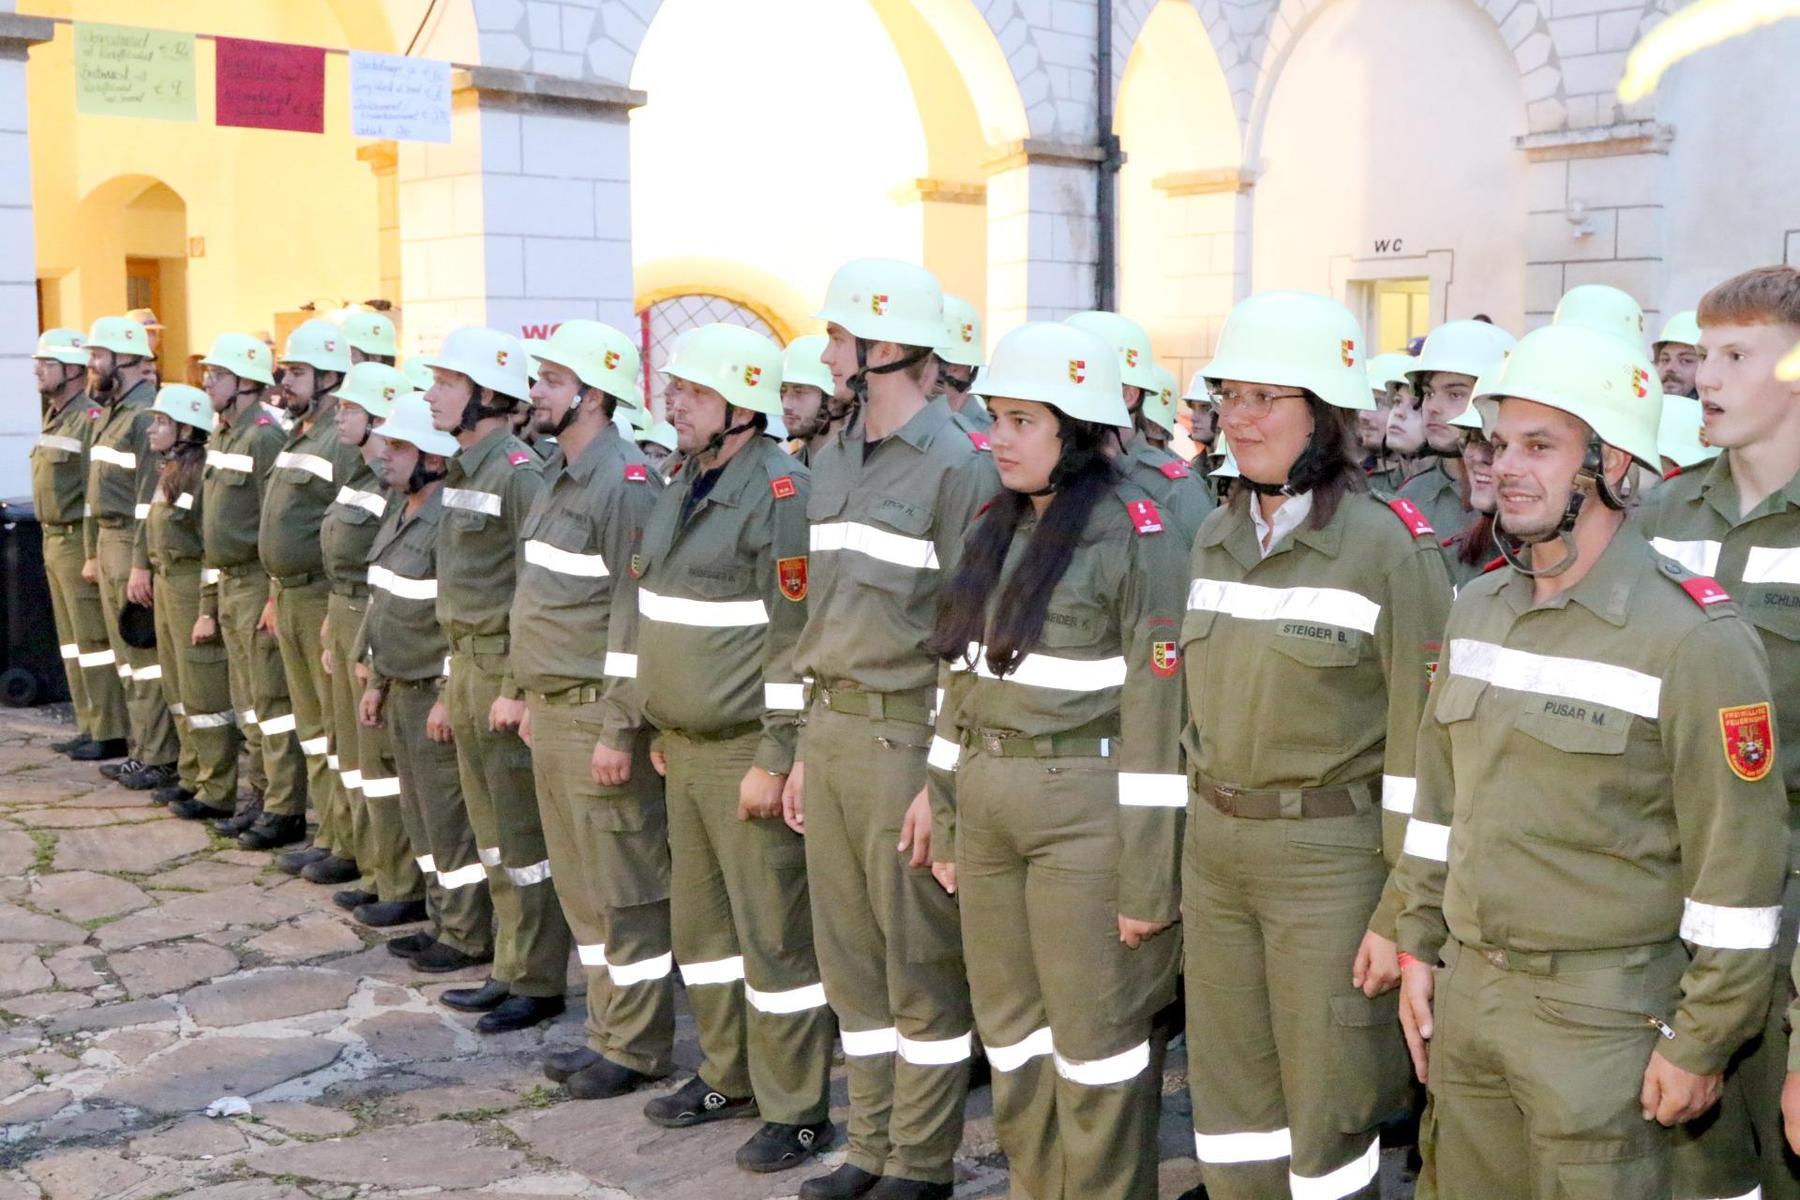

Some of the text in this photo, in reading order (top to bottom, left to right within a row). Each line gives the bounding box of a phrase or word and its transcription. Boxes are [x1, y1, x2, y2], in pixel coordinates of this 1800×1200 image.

[1374, 238, 1403, 253] WC
[1283, 623, 1348, 644] STEIGER B.
[1543, 700, 1586, 721] PUSAR
